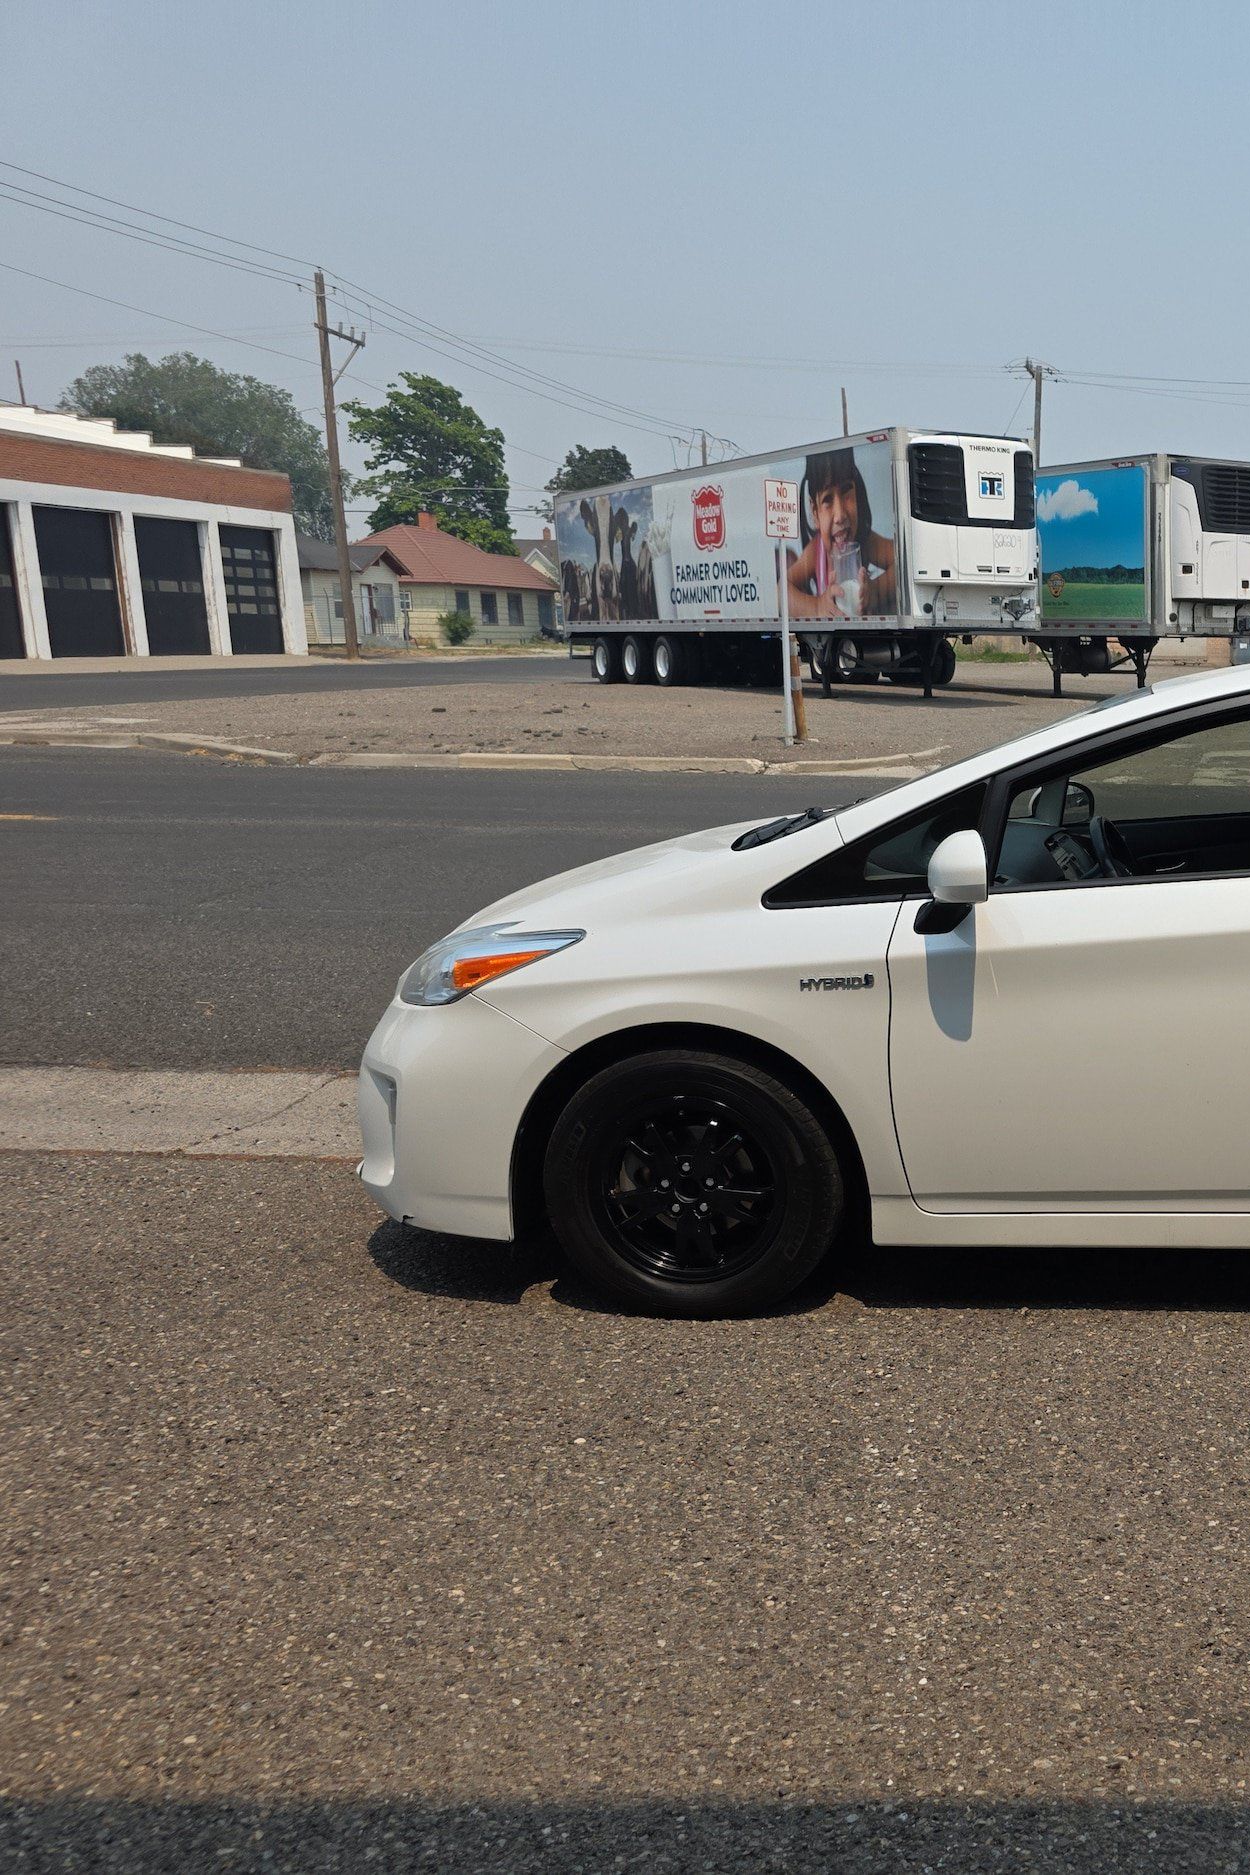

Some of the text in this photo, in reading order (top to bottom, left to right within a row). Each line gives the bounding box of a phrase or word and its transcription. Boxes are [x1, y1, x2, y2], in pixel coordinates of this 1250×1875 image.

[969, 444, 996, 453] THERMO
[776, 486, 788, 499] NO
[696, 502, 721, 519] Meadow
[768, 500, 797, 514] PARKING
[701, 518, 718, 534] Gold
[776, 516, 790, 524] ANY
[776, 525, 790, 533] TIME
[675, 560, 751, 582] FARMER OWNED.
[670, 583, 760, 605] COMMUNITY LOVED.
[799, 976, 863, 992] HYBRID
